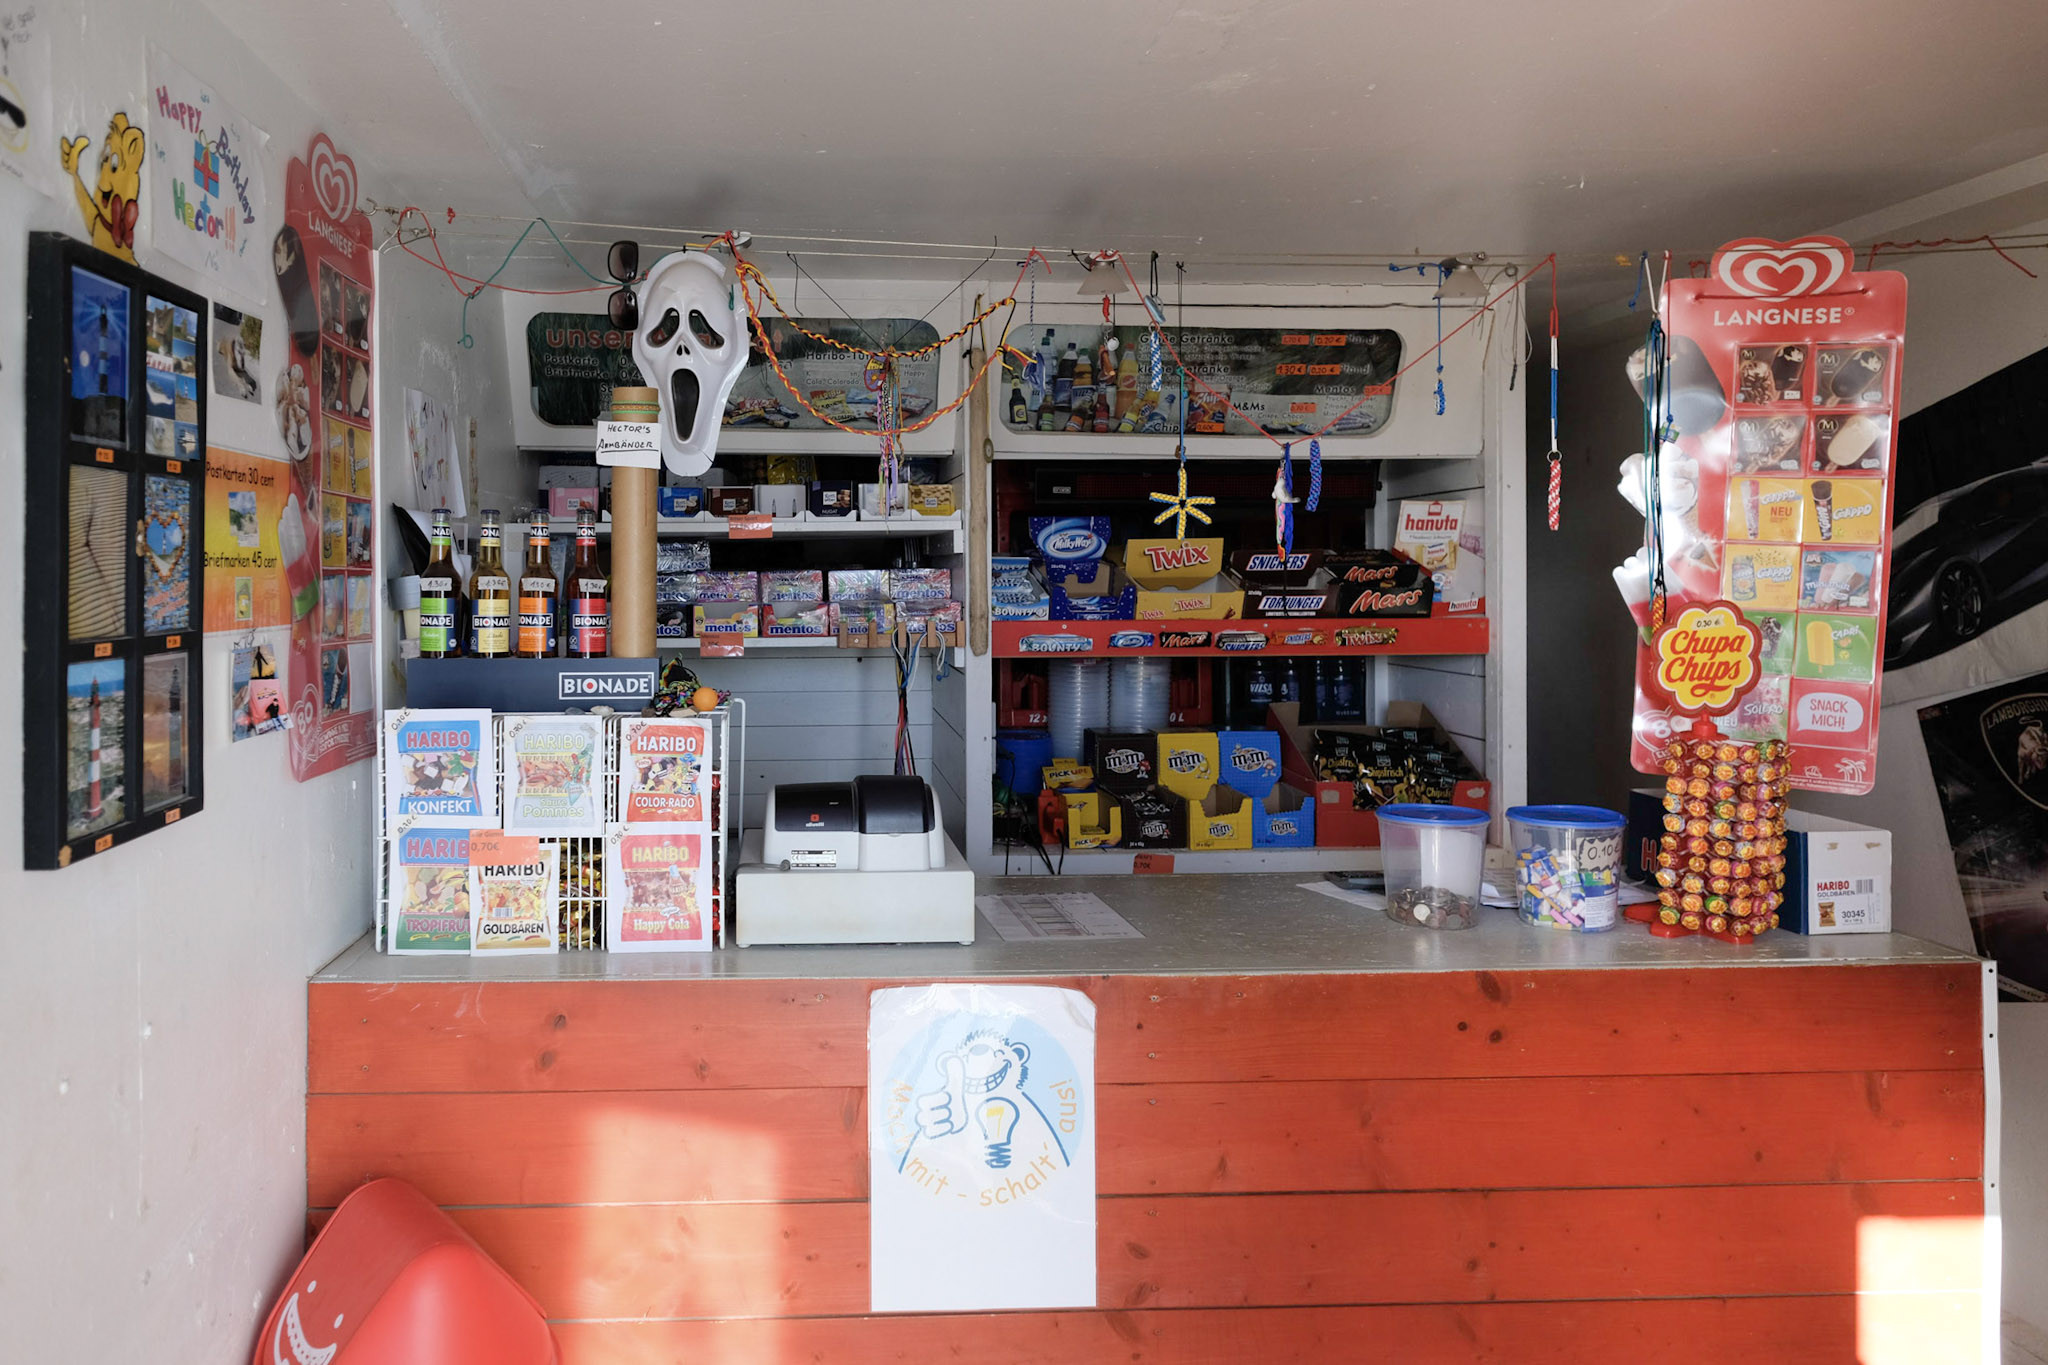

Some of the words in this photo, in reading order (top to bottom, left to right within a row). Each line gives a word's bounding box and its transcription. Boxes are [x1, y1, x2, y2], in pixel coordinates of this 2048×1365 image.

[156, 86, 202, 133] Happy
[308, 211, 353, 259] LANGNESE
[1713, 307, 1842, 326] LANGNESE
[1180, 332, 1234, 343] Getränke
[1232, 402, 1265, 412] M&Ms
[607, 424, 651, 434] HECTOR'S
[206, 461, 246, 482] Postkarten
[248, 468, 259, 485] 30
[261, 474, 275, 487] cent
[1770, 506, 1793, 517] NEU
[1405, 513, 1458, 531] hanuta
[204, 551, 250, 568] Briefmarken
[252, 551, 263, 569] 45
[264, 557, 277, 568] cent
[1145, 543, 1210, 572] Twix
[1344, 565, 1398, 583] Mars
[896, 589, 946, 599] mentos
[1178, 599, 1205, 611] Twix
[1349, 590, 1423, 614] Mars
[1450, 599, 1478, 610] hanuta
[994, 608, 1034, 616] BOUNTY
[769, 625, 822, 635] mentos
[1163, 633, 1206, 648] Mars
[1670, 630, 1746, 657] Chupa
[1665, 656, 1741, 687] Chups
[563, 678, 649, 694] BIONADE
[1250, 683, 1273, 695] VILSA
[1744, 703, 1784, 716] SOLERO
[1810, 699, 1848, 713] SNACK
[1029, 713, 1040, 723] 12
[1811, 715, 1846, 729] MICH!
[407, 731, 470, 748] HARIBO
[524, 734, 585, 750] HARIBO
[637, 736, 697, 752] HARIBO
[408, 800, 472, 814] KONFEKT
[635, 797, 695, 809] COLOR-RADO
[523, 805, 585, 818] Pommes
[407, 838, 469, 858] HARIB
[632, 846, 690, 863] HARIBO
[484, 861, 545, 877] HARIBO
[1817, 880, 1850, 891] HARIBO
[1842, 910, 1866, 919] 30345
[483, 921, 544, 935] GOLDBÄREN
[633, 919, 666, 934] Happy
[668, 918, 690, 931] Cola
[906, 1156, 948, 1196] mit
[979, 1154, 1056, 1207] schalt
